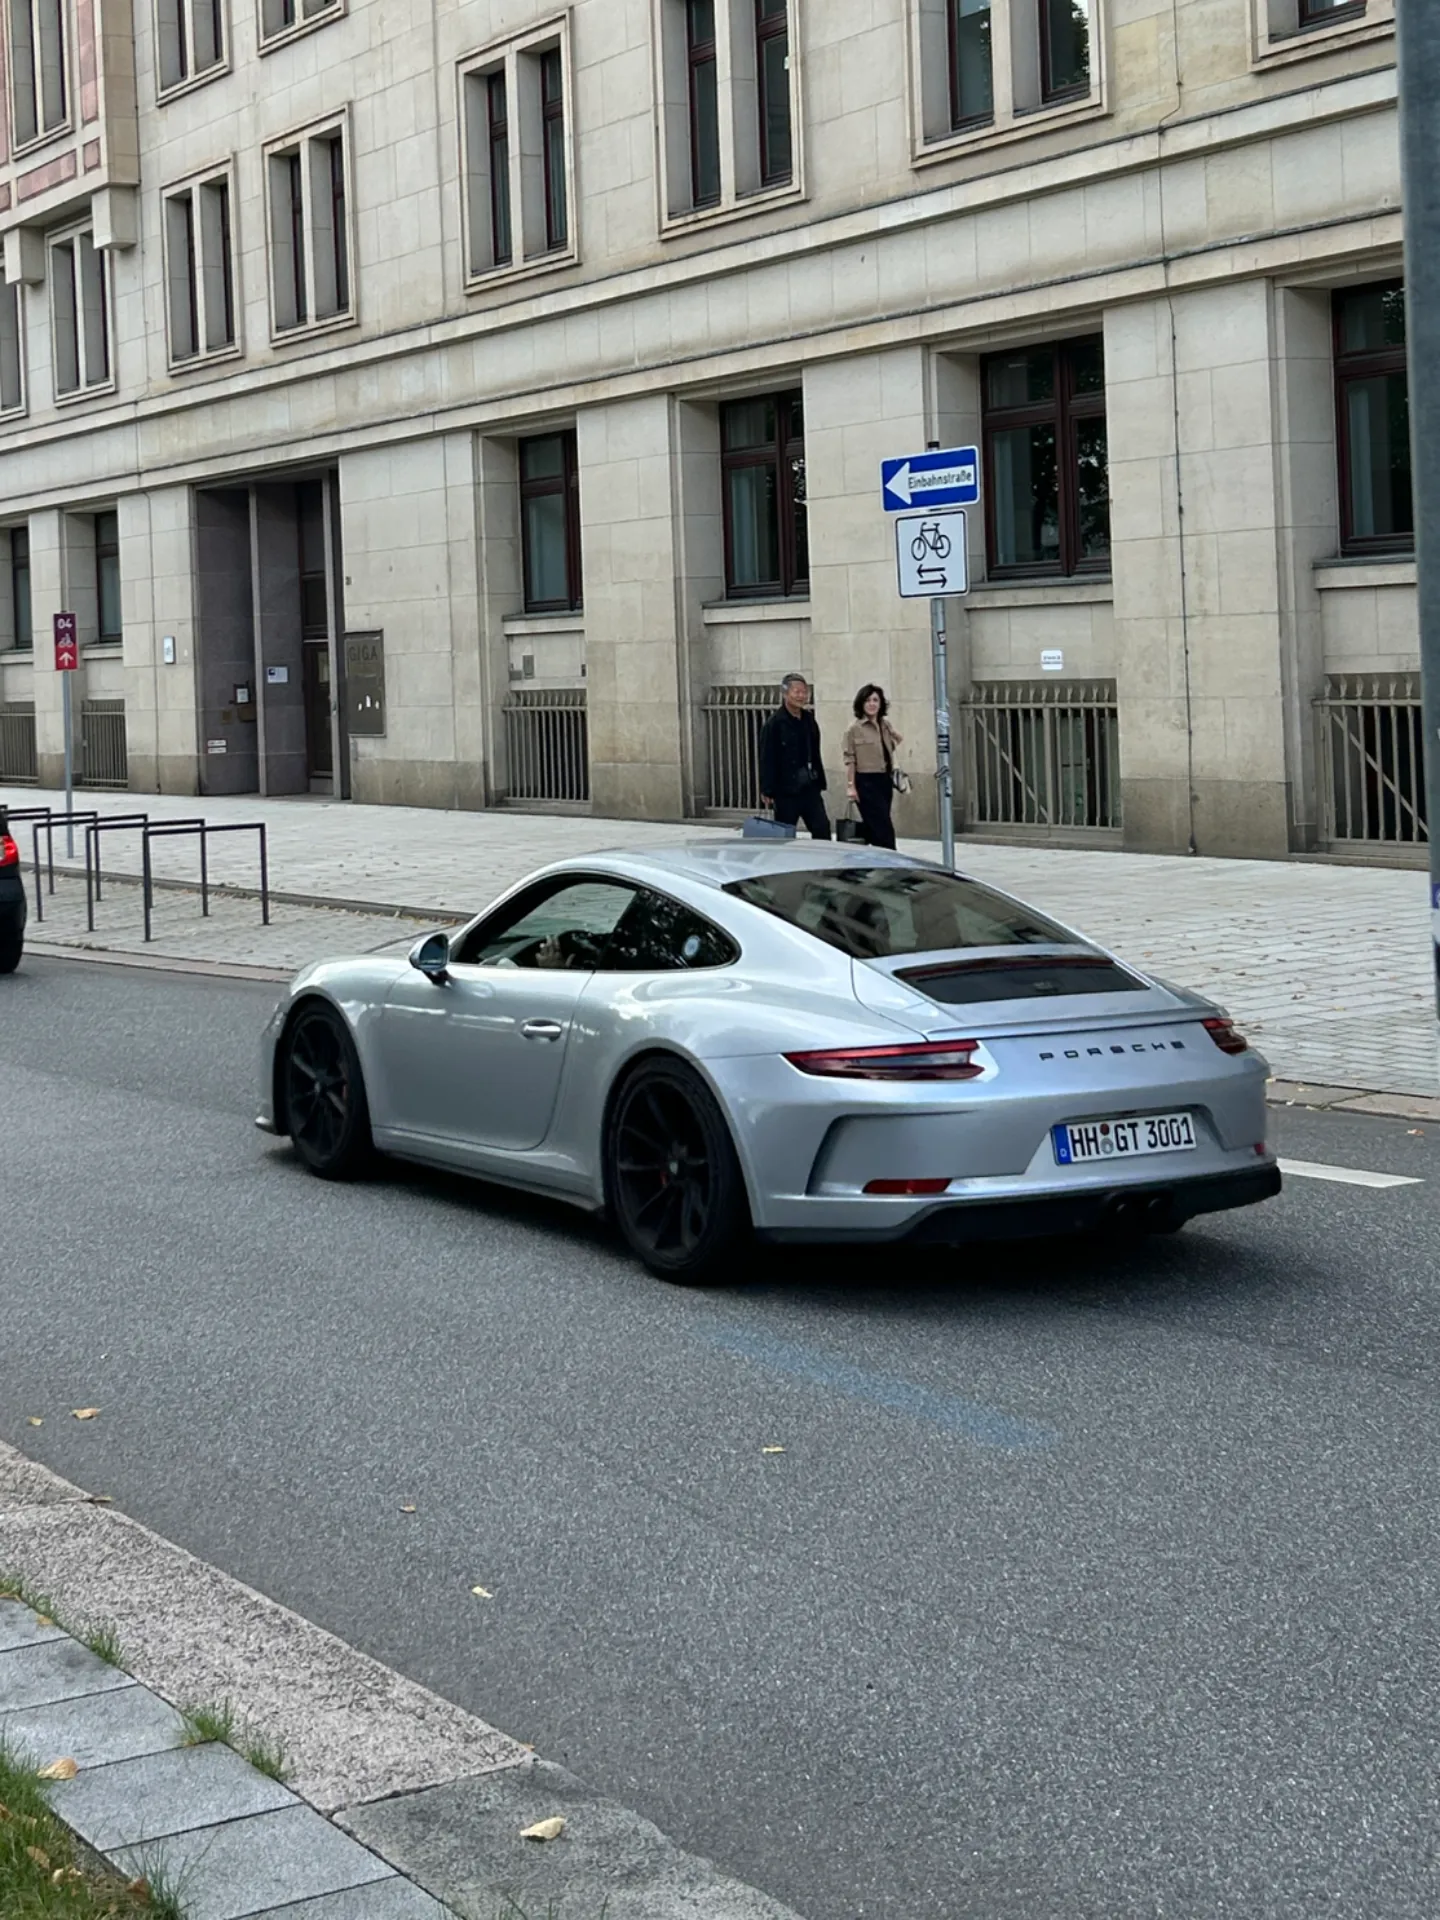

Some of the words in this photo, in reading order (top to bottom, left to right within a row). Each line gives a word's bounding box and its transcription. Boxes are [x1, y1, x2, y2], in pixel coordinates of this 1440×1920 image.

[908, 469, 972, 489] Einbahnstraße
[57, 618, 73, 629] 04
[348, 644, 378, 661] GIGA
[1039, 1040, 1186, 1061] PORSCHE
[1069, 1125, 1100, 1158] HH
[1115, 1122, 1139, 1151] GT
[1146, 1116, 1193, 1148] 3001
